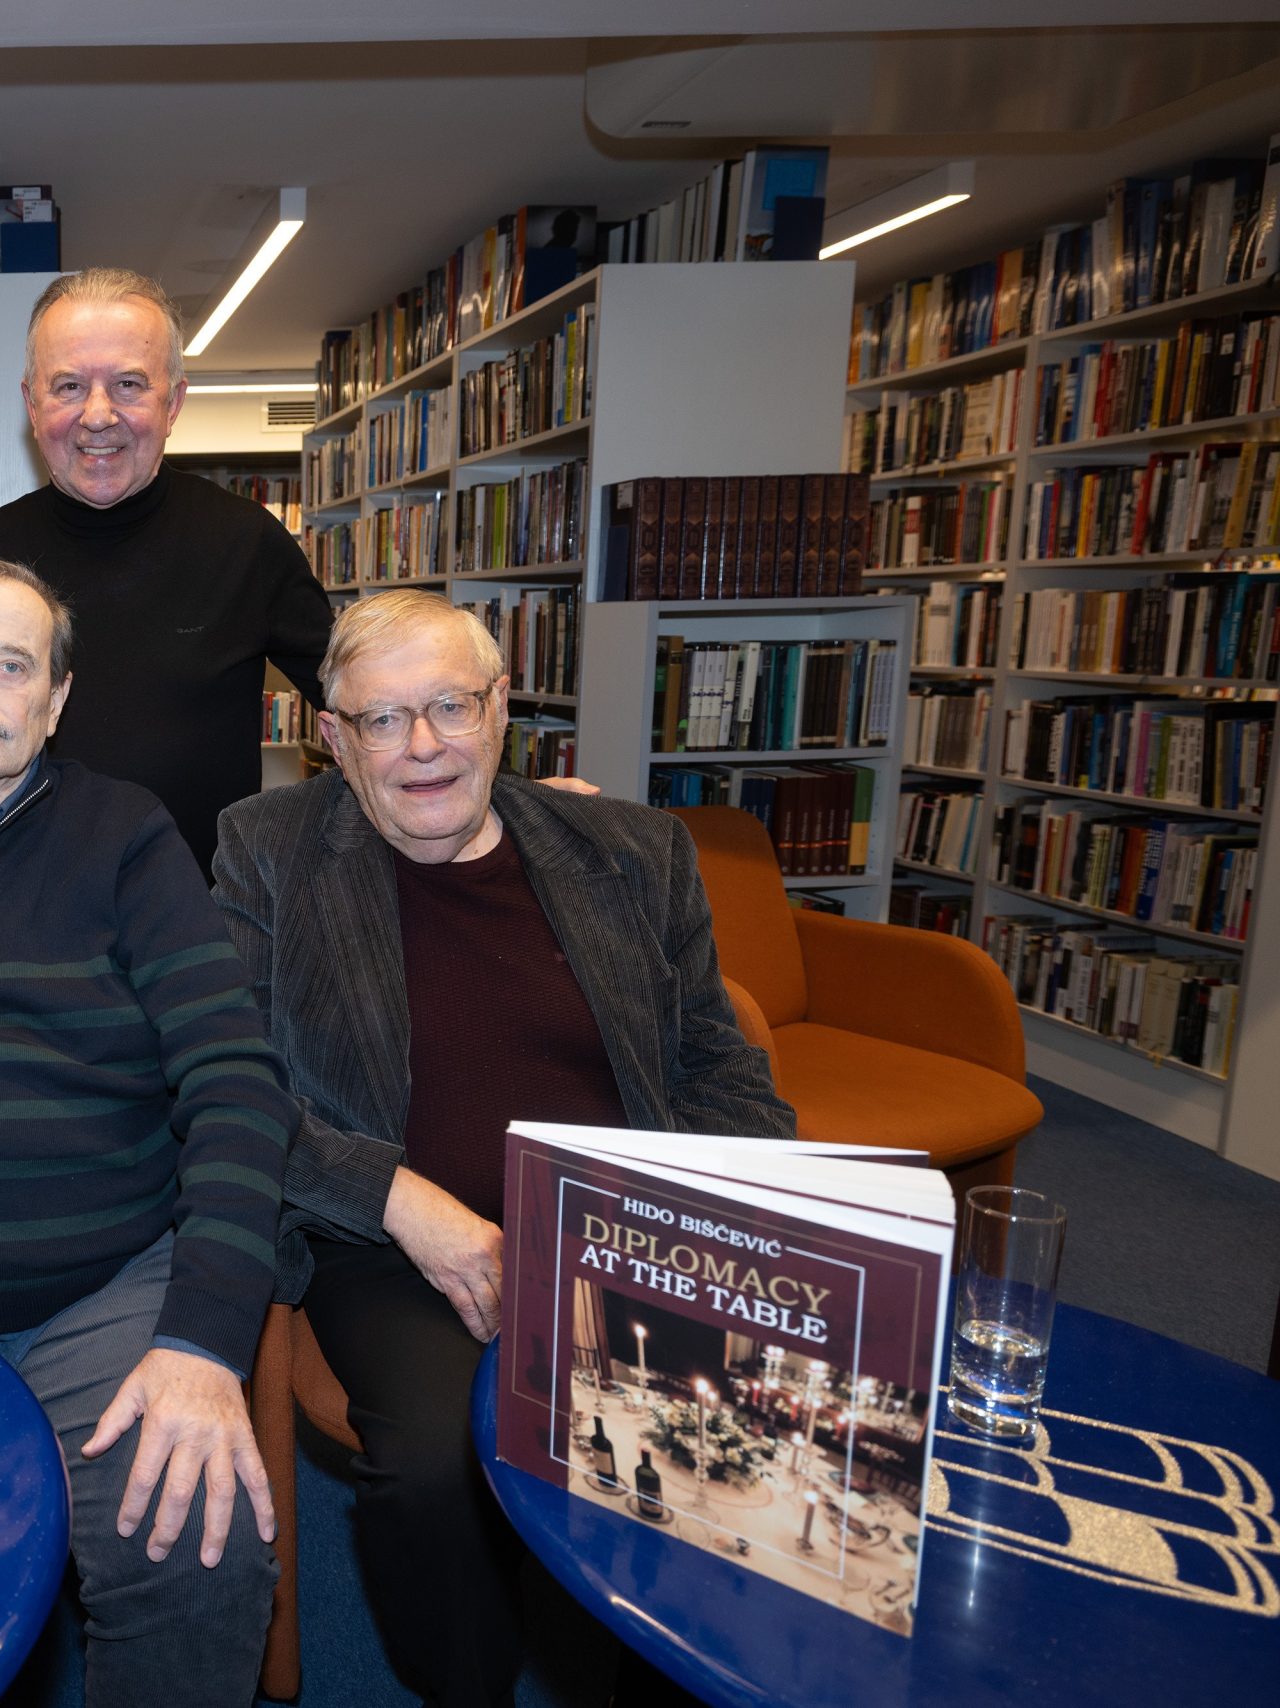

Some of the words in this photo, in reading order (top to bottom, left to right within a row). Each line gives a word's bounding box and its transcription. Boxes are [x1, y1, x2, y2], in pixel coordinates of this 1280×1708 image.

[582, 1213, 832, 1315] DIPLOMACY
[622, 1196, 675, 1225] HIDO
[680, 1213, 783, 1258] BIŠČEVIĆ
[579, 1244, 621, 1274] AT
[627, 1257, 697, 1302] THE
[705, 1283, 828, 1344] TABLE
